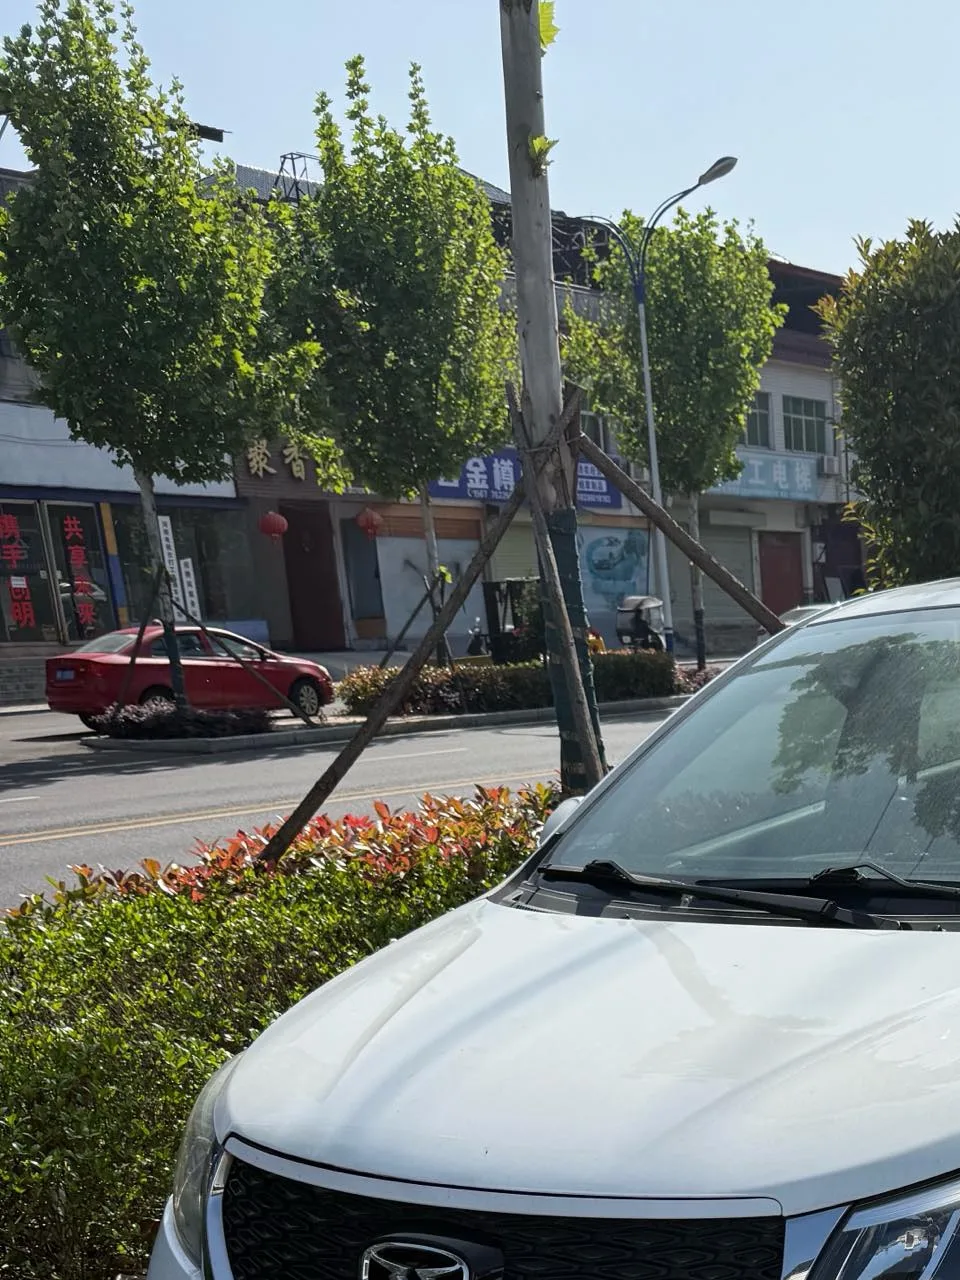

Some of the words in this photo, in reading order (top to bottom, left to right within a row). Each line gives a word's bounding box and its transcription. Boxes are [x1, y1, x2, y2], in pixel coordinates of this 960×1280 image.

[247, 438, 342, 480] 聚香
[728, 459, 812, 492] 工电梯
